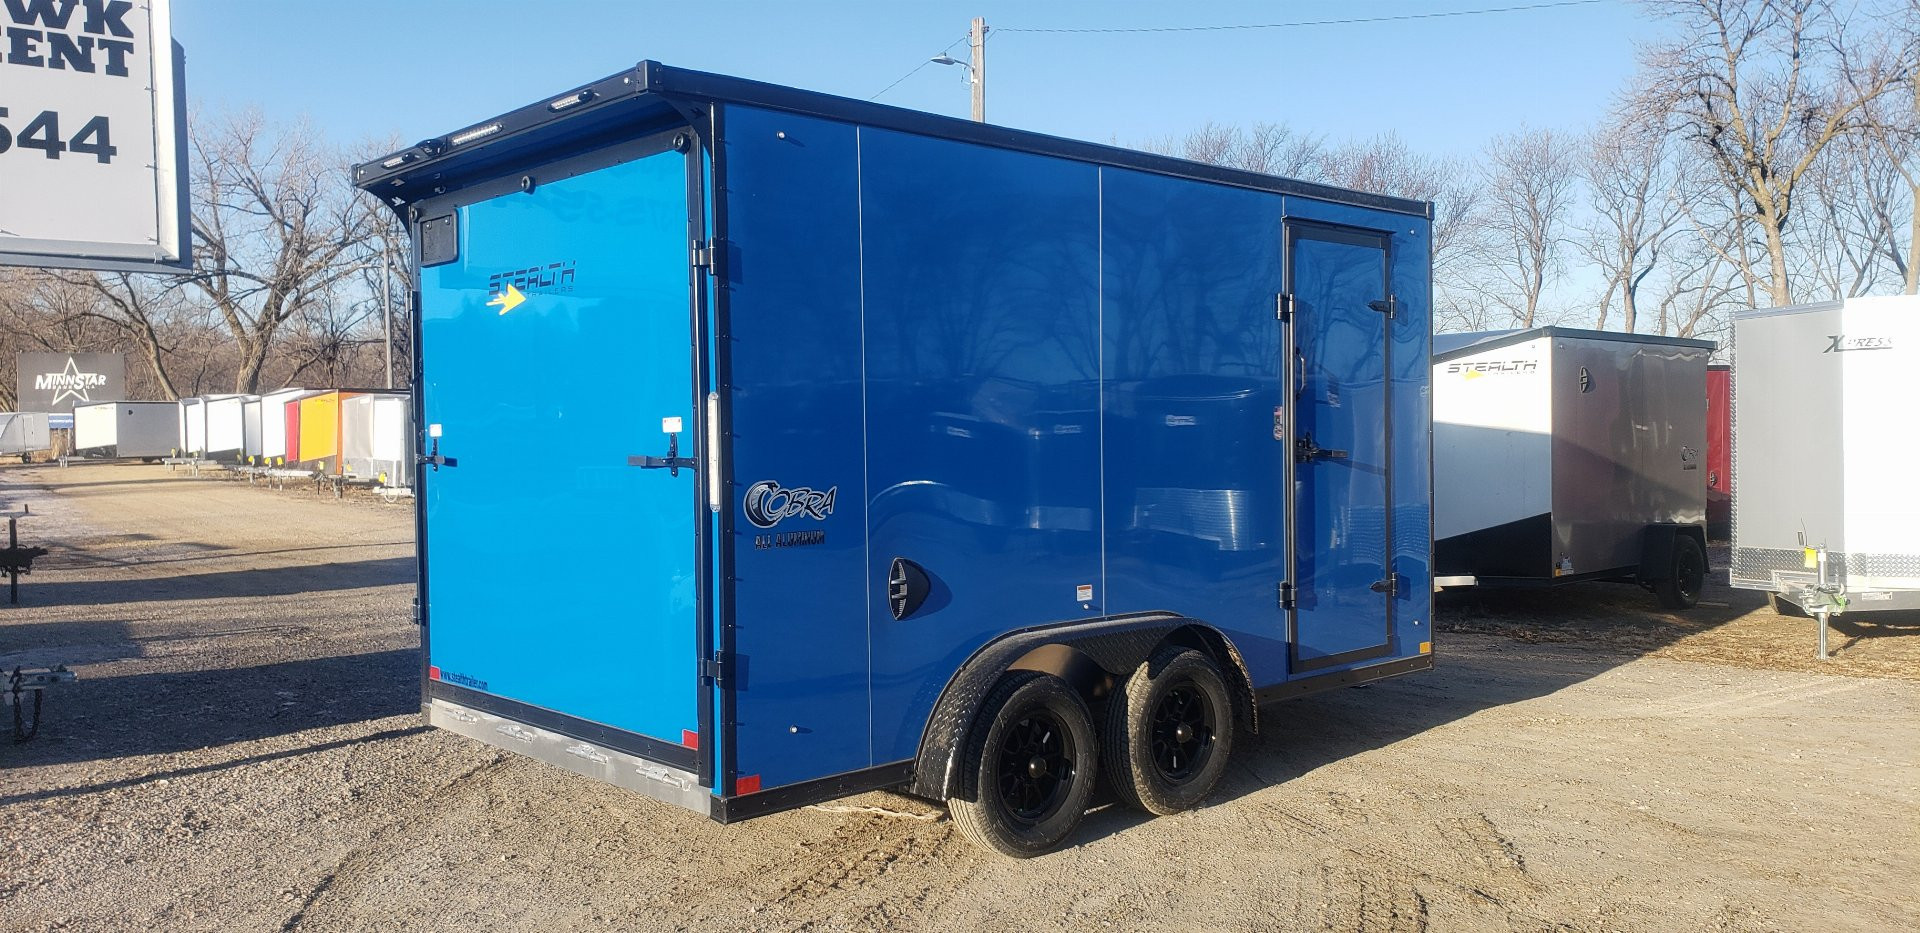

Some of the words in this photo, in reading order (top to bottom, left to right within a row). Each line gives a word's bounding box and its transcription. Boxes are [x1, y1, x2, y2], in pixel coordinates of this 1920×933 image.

[0, 25, 134, 77] ENT
[0, 107, 118, 164] 44
[488, 260, 577, 295] STEALTH
[1447, 360, 1538, 373] STEALTH
[743, 480, 838, 528] COBRA
[755, 535, 772, 550] ALL
[775, 530, 825, 548] ALUMINUM
